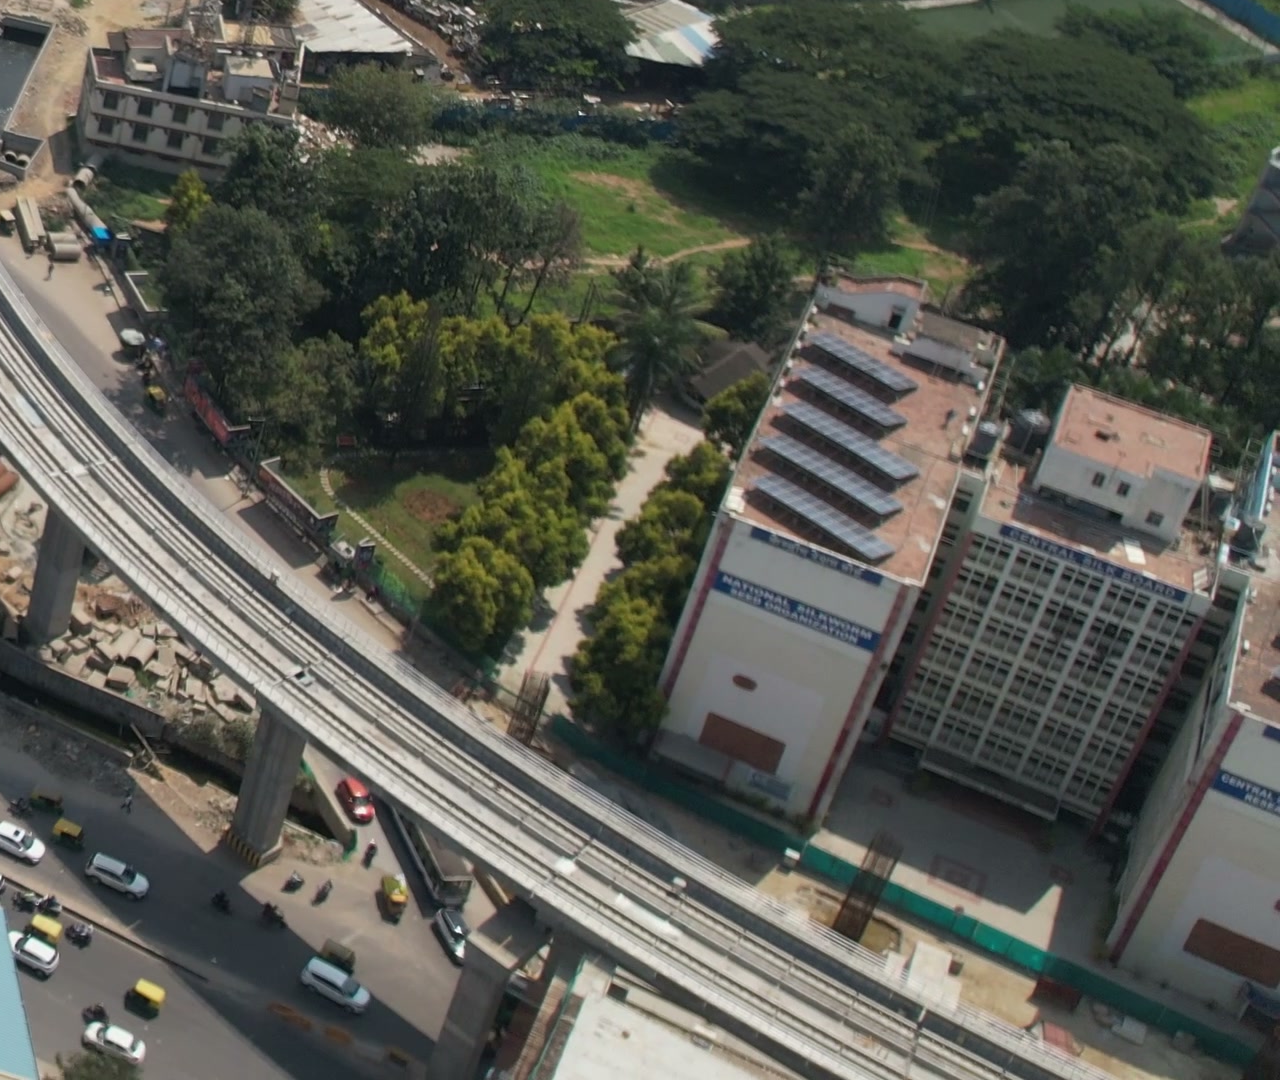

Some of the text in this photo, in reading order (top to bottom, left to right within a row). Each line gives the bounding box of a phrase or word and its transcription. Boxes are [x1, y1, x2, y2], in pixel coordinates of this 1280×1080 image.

[1009, 529, 1176, 598] CENTRAL SILK BOARD
[722, 574, 873, 641] NATIONAL SILKWORM
[730, 588, 858, 644] SEED ORGANIZATION
[1221, 773, 1273, 800] CENTRAL
